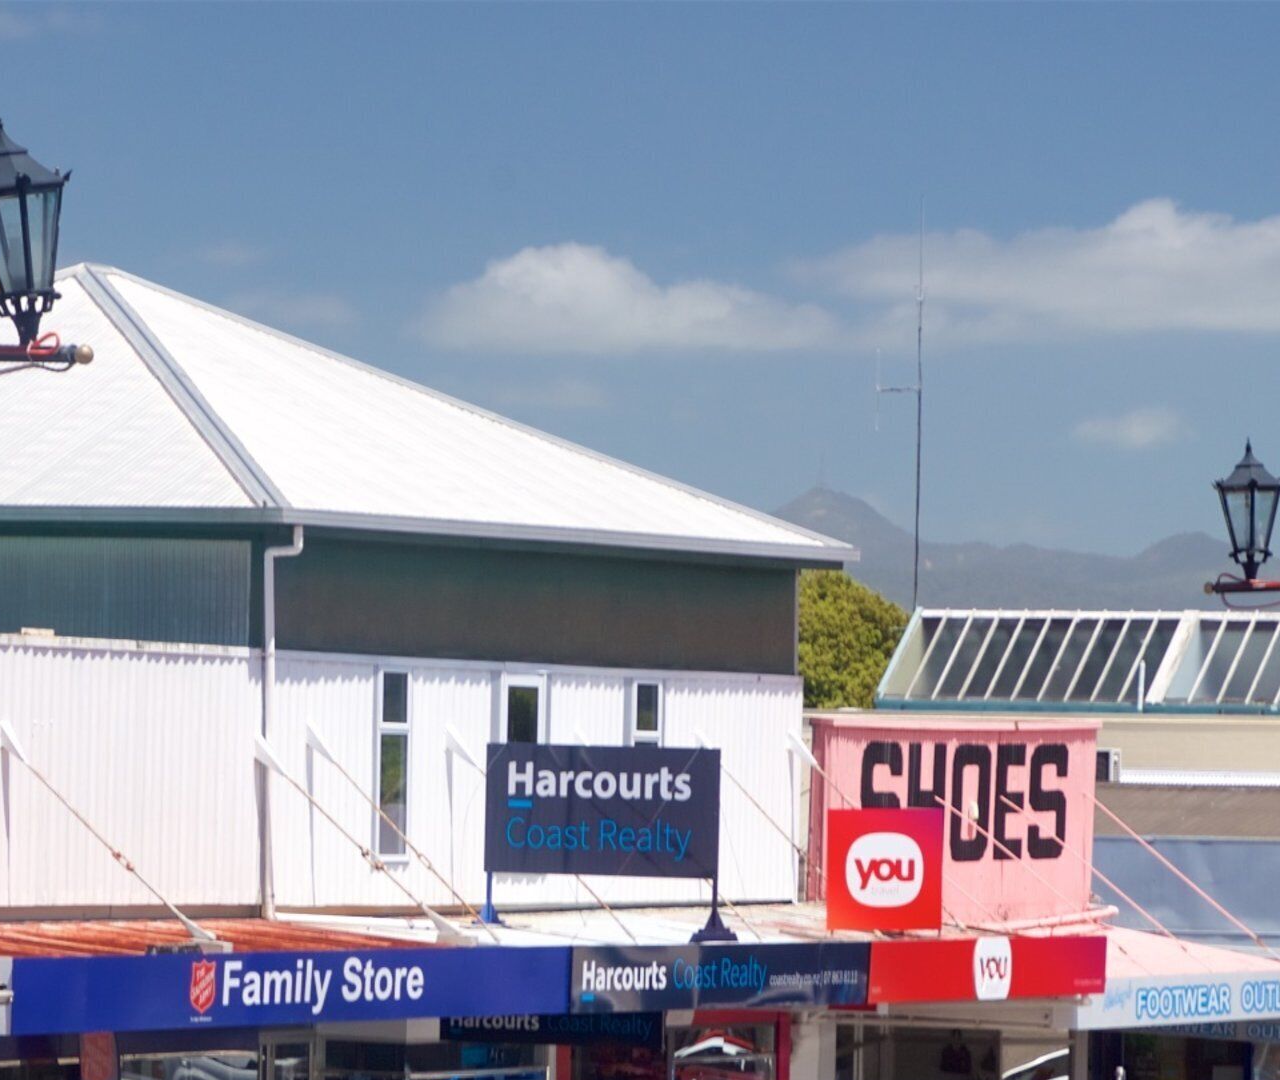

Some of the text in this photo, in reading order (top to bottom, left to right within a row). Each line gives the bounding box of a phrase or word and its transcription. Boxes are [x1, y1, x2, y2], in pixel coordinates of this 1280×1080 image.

[507, 760, 692, 801] Harcourts
[861, 742, 1069, 861] SHOES
[506, 816, 692, 861] Coast Realty
[855, 858, 915, 890] you
[222, 956, 424, 1015] Family Store
[582, 959, 667, 991] Harcourts
[673, 957, 718, 990] Coast
[719, 956, 768, 994] Realty
[979, 956, 1008, 983] you
[1136, 983, 1232, 1020] FOOTWEAR
